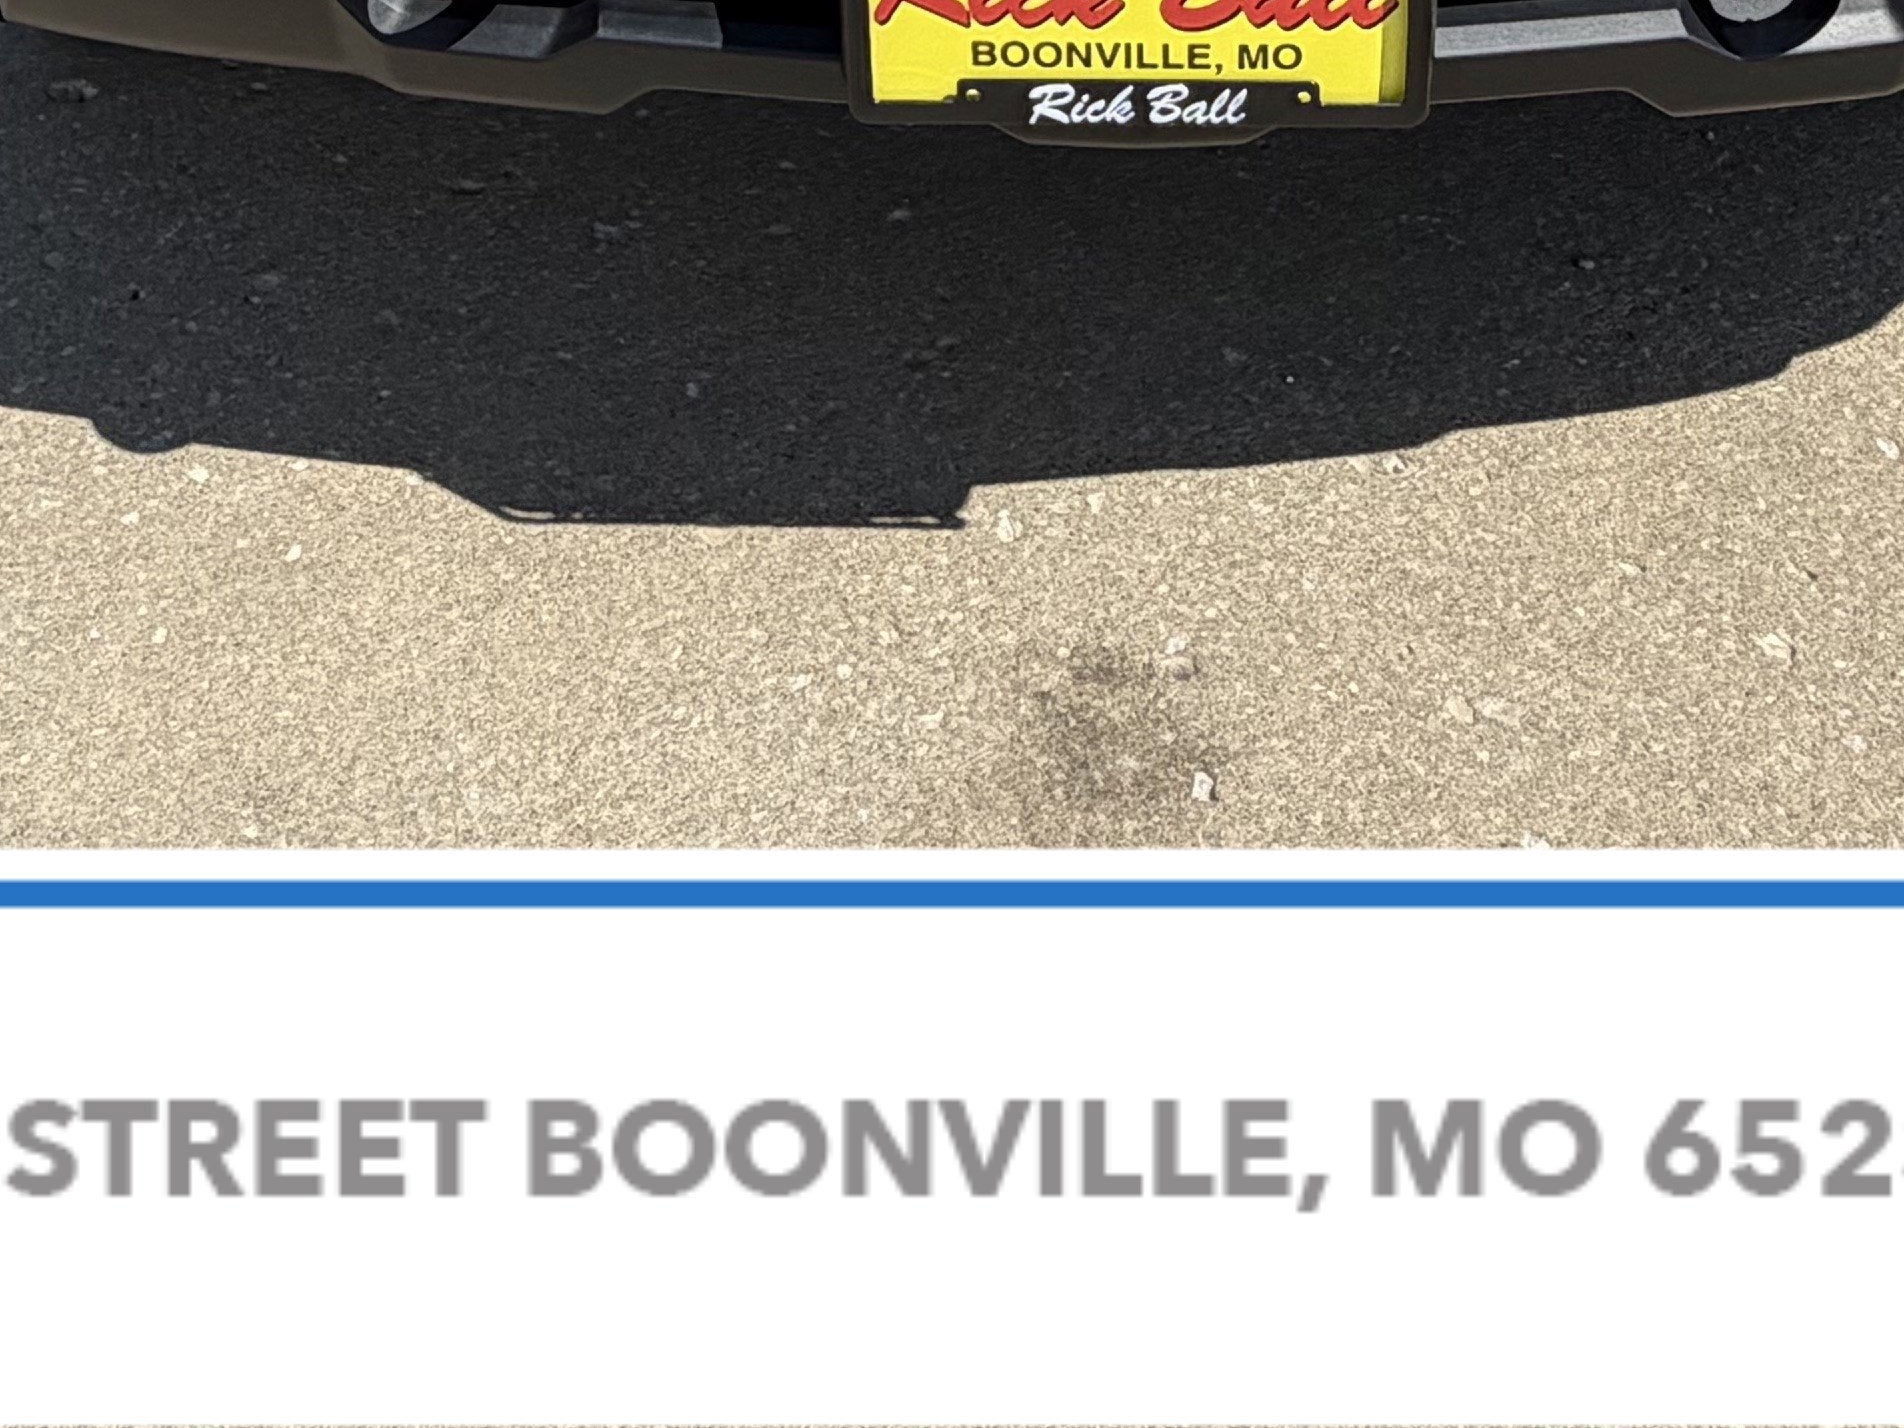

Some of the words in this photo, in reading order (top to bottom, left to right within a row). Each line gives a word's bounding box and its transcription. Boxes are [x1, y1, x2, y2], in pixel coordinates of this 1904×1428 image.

[970, 40, 1223, 75] BOONVILLE,
[1237, 44, 1303, 71] MO
[1028, 83, 1136, 125] Rick
[1146, 83, 1248, 125] Ball
